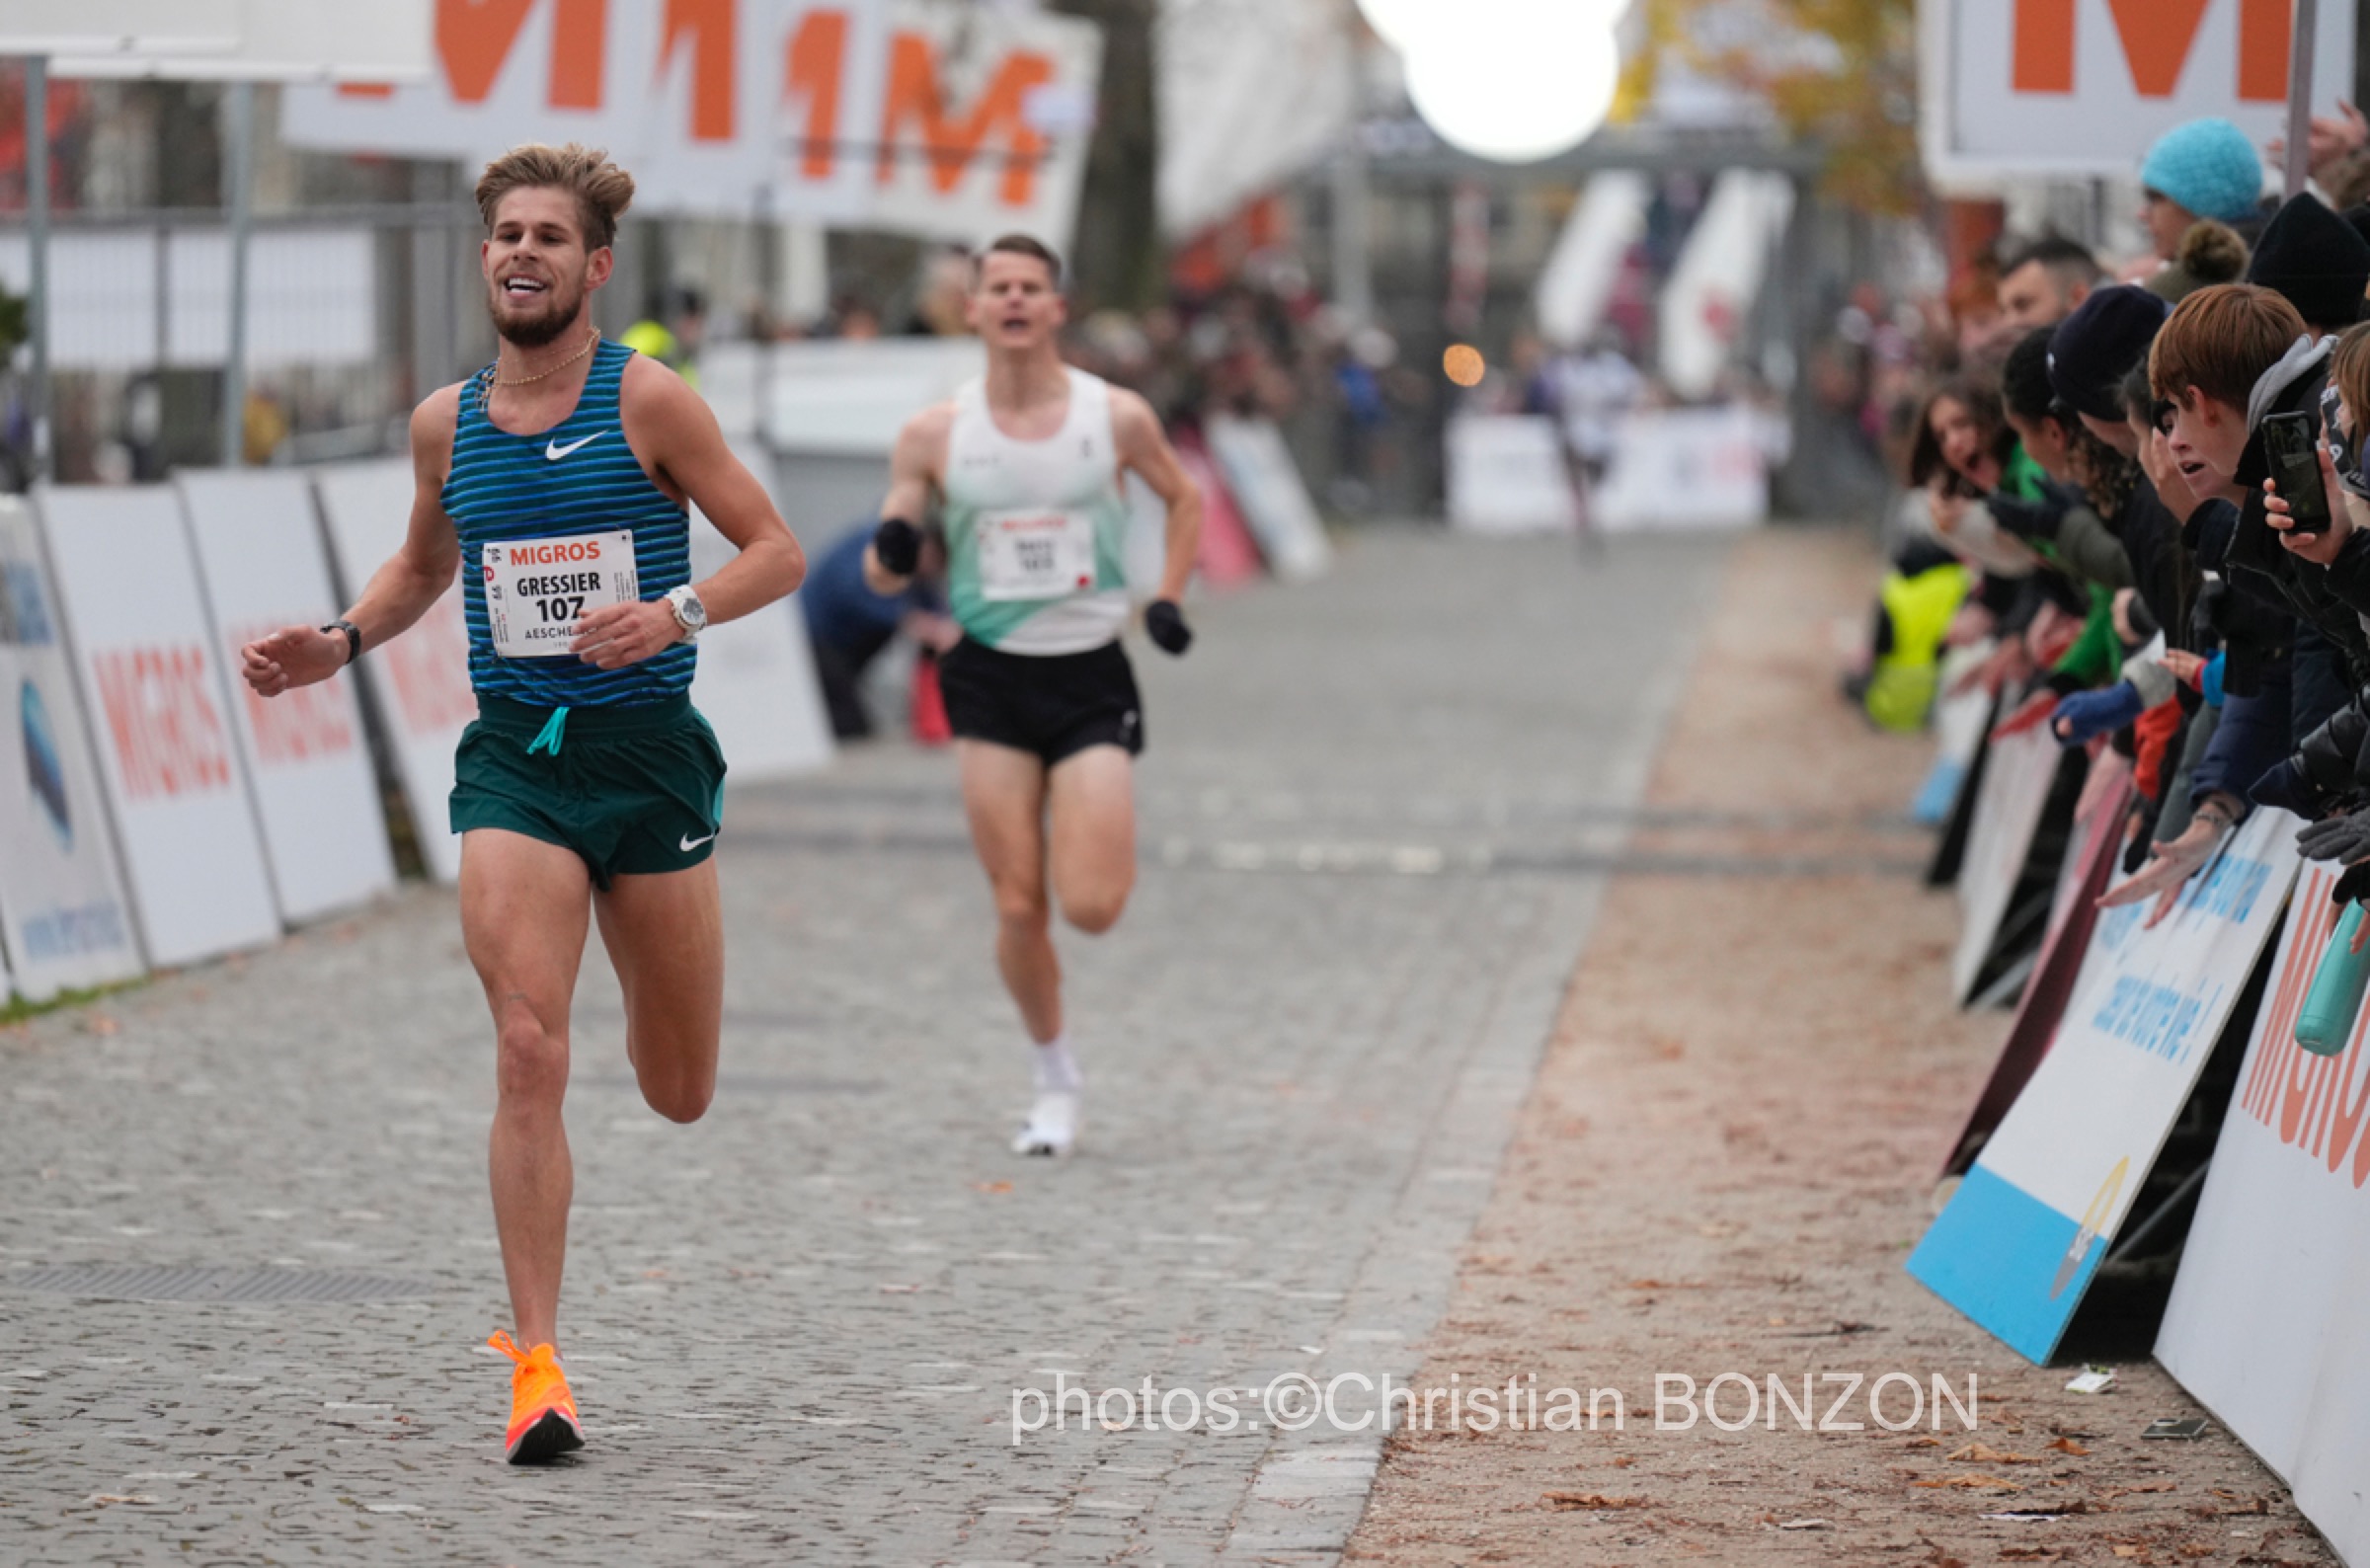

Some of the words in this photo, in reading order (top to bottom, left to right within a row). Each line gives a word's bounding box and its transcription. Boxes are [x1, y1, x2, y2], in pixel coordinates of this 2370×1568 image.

[510, 541, 600, 566] MIGROS
[516, 572, 601, 596] GRESSIER
[534, 595, 585, 622] 107
